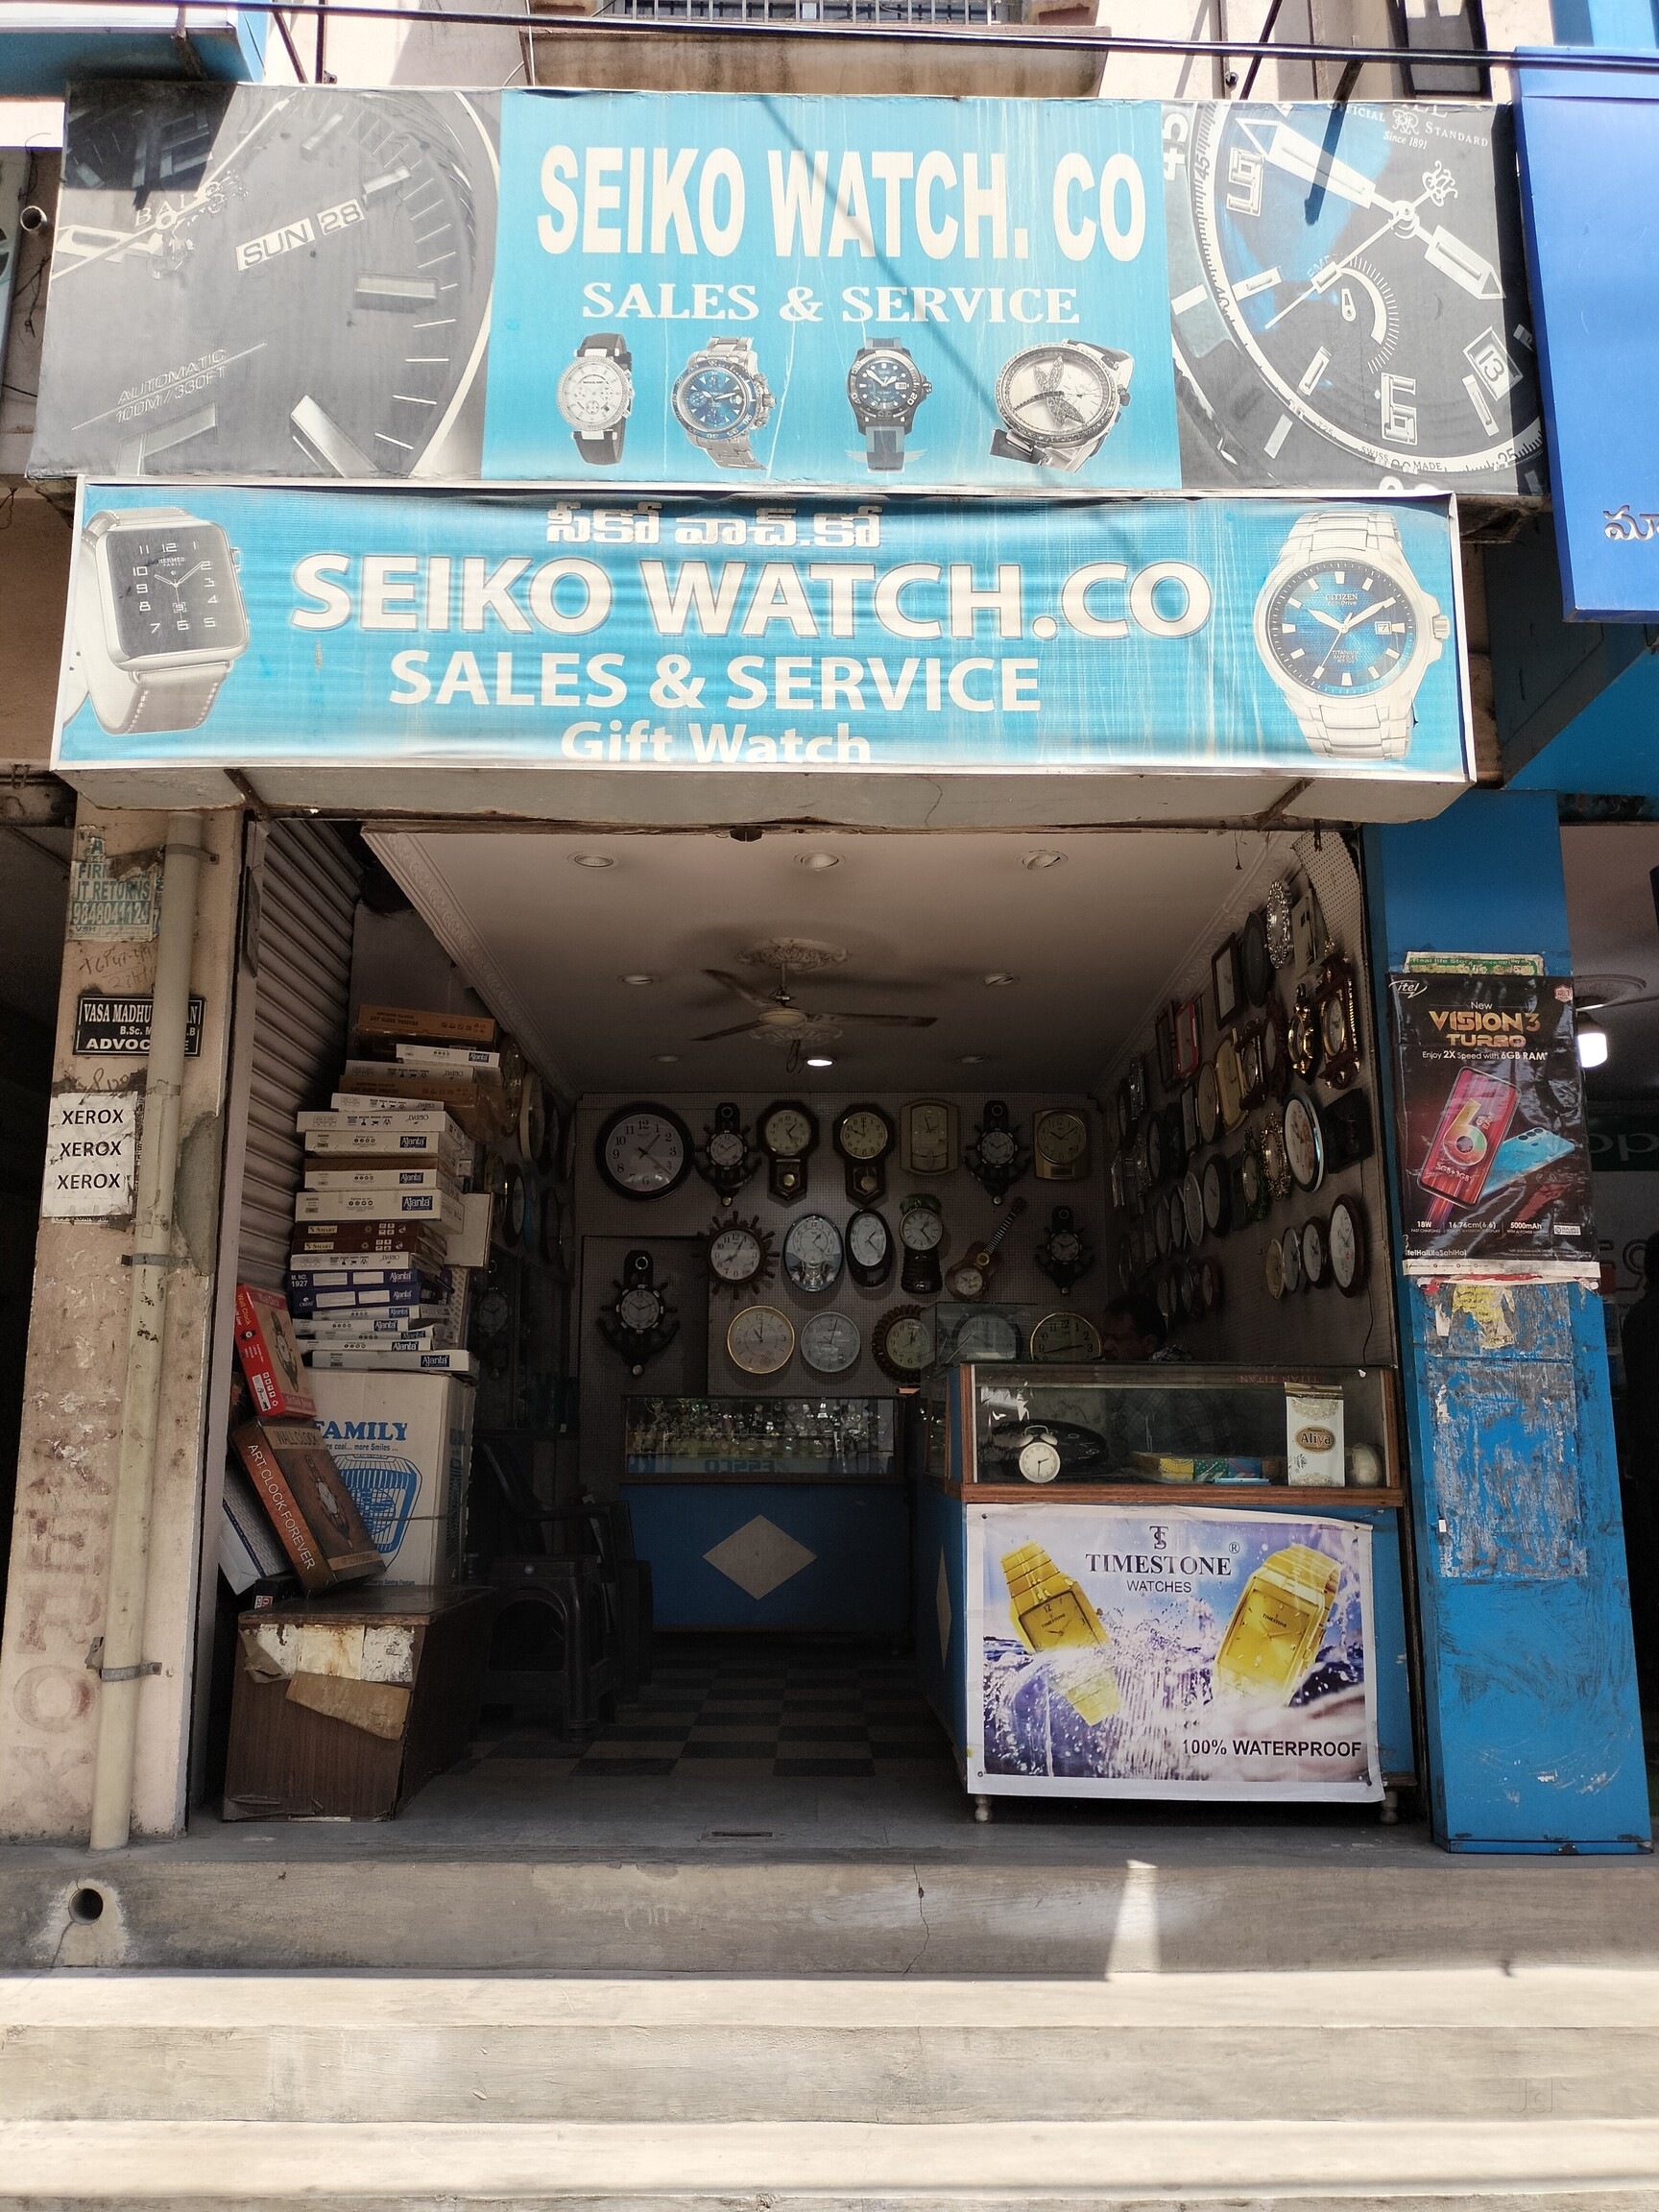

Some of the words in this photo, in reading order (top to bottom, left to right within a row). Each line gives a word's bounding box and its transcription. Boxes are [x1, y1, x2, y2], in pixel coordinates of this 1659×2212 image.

[1383, 131, 1407, 144] Since
[1409, 136, 1427, 150] 1891
[538, 145, 745, 255] SEIKO
[768, 149, 1028, 259] WATCH.
[1056, 153, 1146, 261] CO
[243, 221, 311, 267] SUN
[320, 204, 364, 235] 28
[583, 282, 758, 321] SALES
[780, 287, 823, 322] &
[843, 286, 1079, 324] SERVICE
[117, 349, 227, 404] AUTOMATIC
[115, 395, 161, 422] 100M
[174, 366, 227, 398] 330FT
[290, 553, 613, 635] SEIKO
[639, 559, 1213, 640] WATCH.CO
[389, 649, 627, 707] SALES
[649, 654, 706, 709] &
[727, 656, 1041, 711] SERVICE
[561, 720, 672, 762] Gift
[688, 723, 871, 763] Watch
[93, 881, 151, 901] RETURNS
[84, 1003, 110, 1022] VASA
[1471, 1001, 1493, 1010] New
[1429, 1010, 1524, 1033] VISION
[1525, 1013, 1541, 1032] 3
[1445, 1033, 1527, 1047] TURBO
[1423, 1050, 1441, 1060] Enjoy
[1443, 1050, 1455, 1059] 2X
[1457, 1051, 1481, 1061] Speed
[61, 1109, 124, 1125] XEROX
[1442, 1097, 1488, 1167] 6
[60, 1141, 122, 1157] XEROX
[57, 1173, 121, 1190] XEROX
[403, 1196, 430, 1211] Ajanta
[421, 1356, 449, 1367] Ajanta
[315, 1420, 408, 1441] FAMILY
[1302, 1433, 1331, 1446] Aliya
[248, 1443, 268, 1468] ART
[260, 1468, 287, 1511] CLOCK
[280, 1510, 317, 1570] FOREVER
[1086, 1553, 1233, 1576] TIMESTONE
[1127, 1579, 1192, 1594] WATCHES
[1183, 1740, 1227, 1757] 100%
[1233, 1740, 1361, 1758] WATERPROOF
